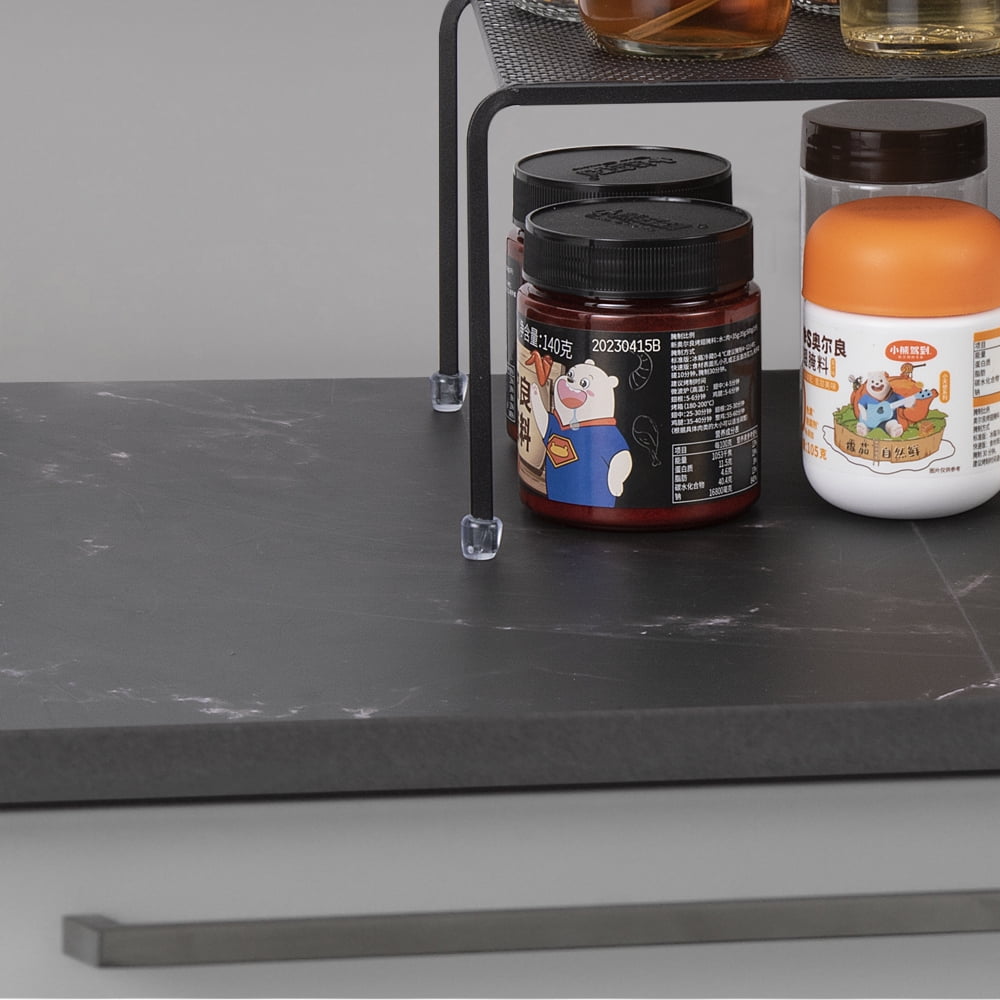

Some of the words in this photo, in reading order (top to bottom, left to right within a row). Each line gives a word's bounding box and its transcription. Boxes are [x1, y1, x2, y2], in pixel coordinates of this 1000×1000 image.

[592, 338, 661, 353] 20230415B
[890, 345, 930, 356] 小熊驾到
